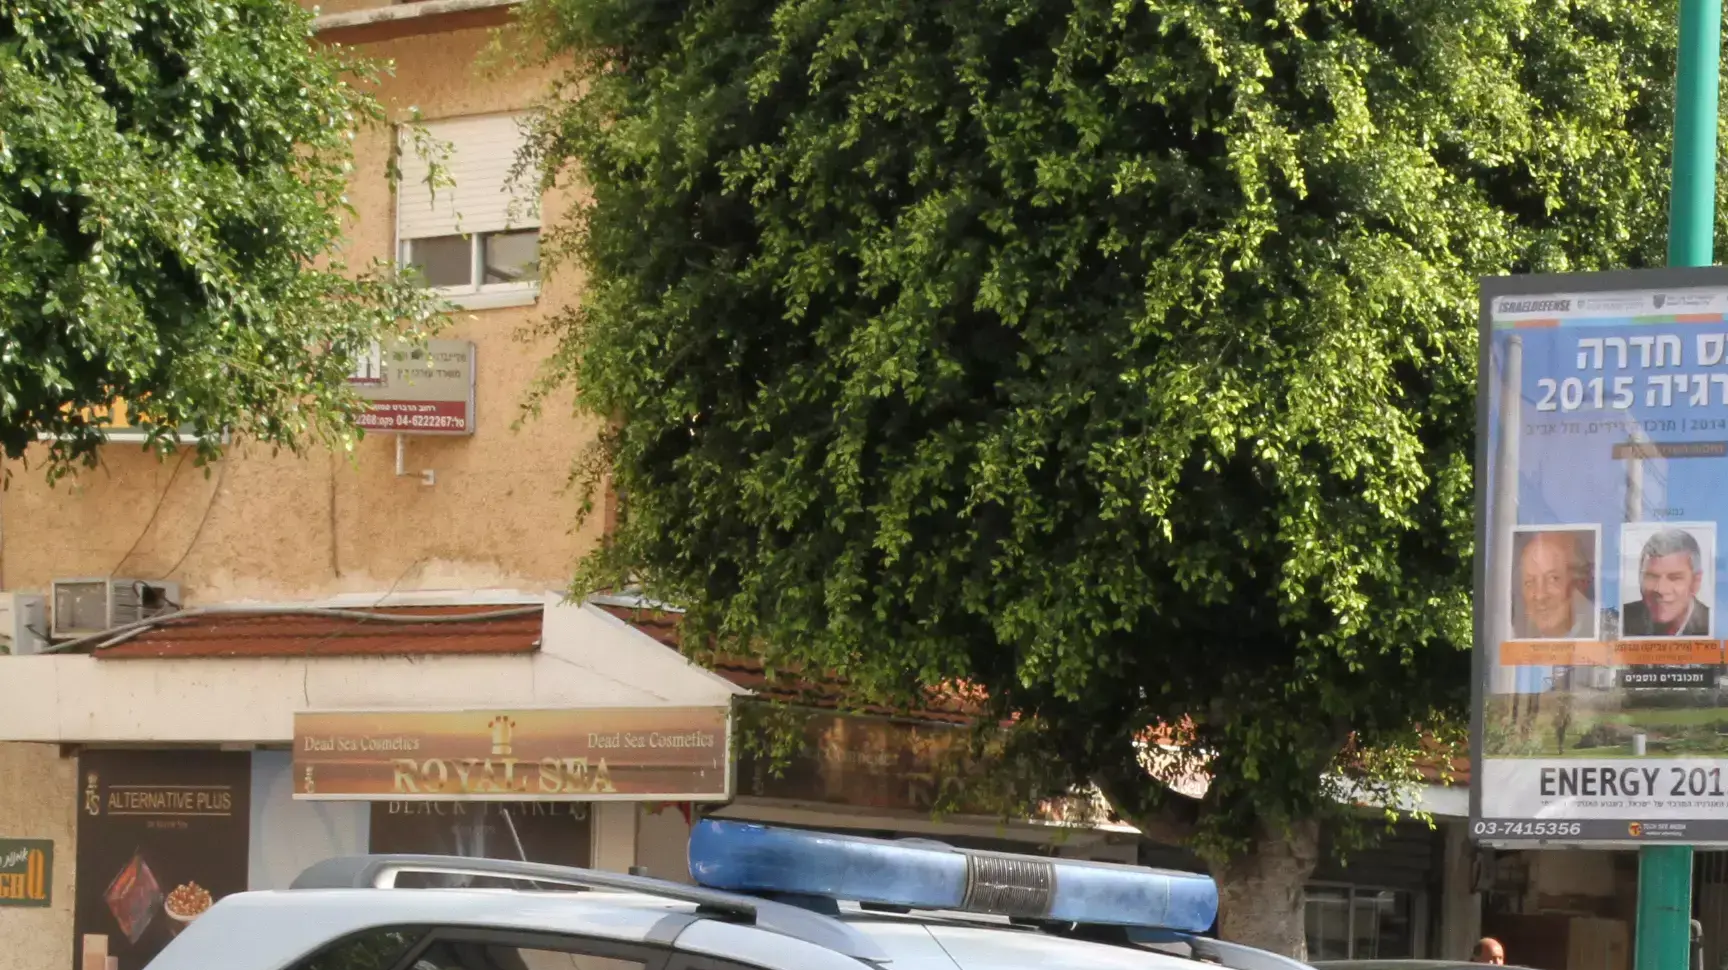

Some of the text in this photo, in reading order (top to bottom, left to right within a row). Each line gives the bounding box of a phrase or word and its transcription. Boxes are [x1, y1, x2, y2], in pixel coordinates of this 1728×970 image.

[1576, 334, 1682, 370] חדרה
[1536, 376, 1634, 411] 2015
[1690, 418, 1726, 431] 2014
[304, 735, 419, 751] Dead Sea Cosmetics
[588, 730, 714, 749] Dead Sea Cosmetics
[390, 757, 617, 793] ROYAL SEA
[1540, 767, 1660, 796] ENERGY
[108, 791, 232, 810] ALTERNATIVE PLUS
[1474, 822, 1581, 836] 03-7415356
